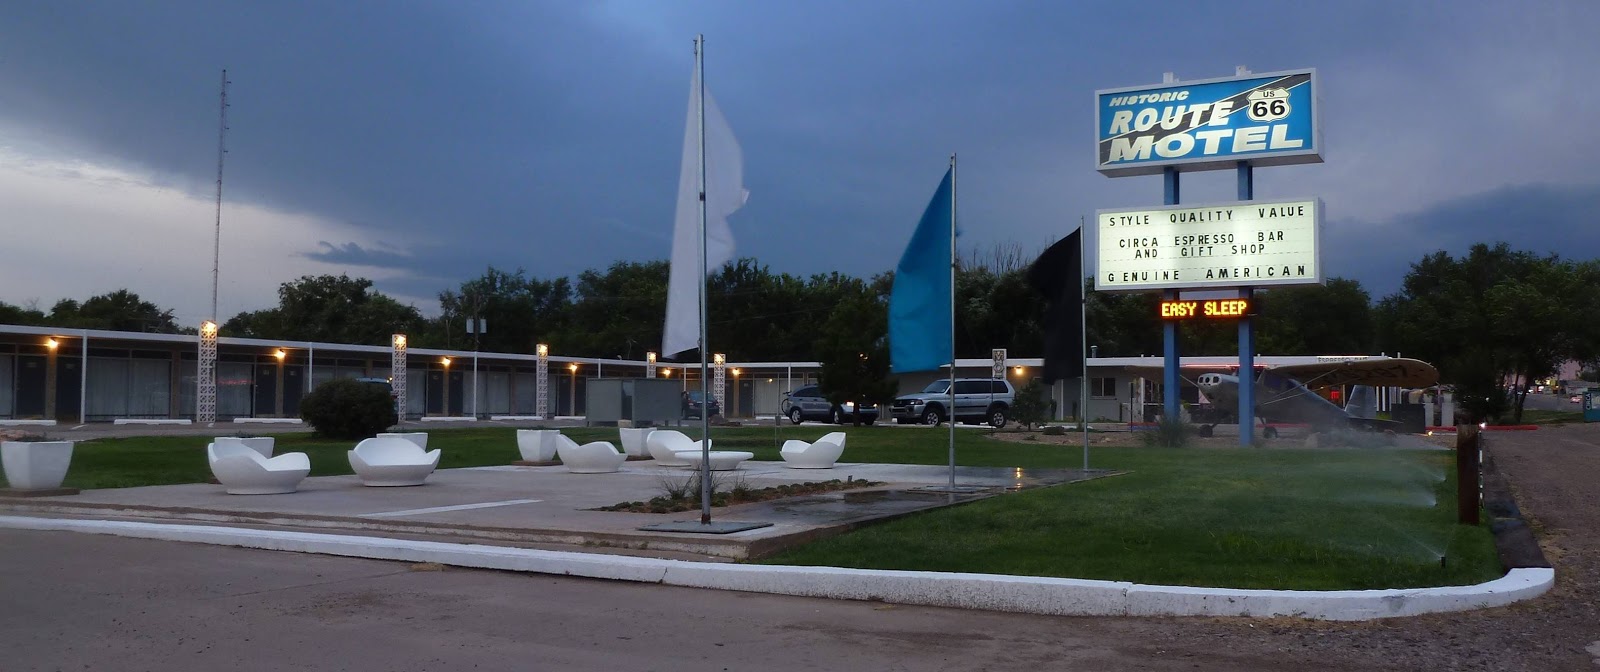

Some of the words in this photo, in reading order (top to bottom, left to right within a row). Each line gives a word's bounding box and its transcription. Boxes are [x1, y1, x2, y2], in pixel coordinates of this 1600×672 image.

[1109, 90, 1190, 107] HISTORIC
[1262, 90, 1275, 98] US
[1252, 99, 1286, 118] 66
[1109, 100, 1234, 135] ROUTE
[1108, 124, 1304, 162] MOTEL
[1109, 214, 1150, 227] STYLE
[1169, 210, 1233, 223] QUALITY
[1258, 205, 1304, 218] VALUE
[1119, 237, 1159, 248] CIRCA
[1174, 233, 1234, 246] ESPRESSO
[1258, 230, 1284, 242] BAR
[1134, 248, 1158, 259] AND
[1181, 246, 1214, 257] GIFT
[1231, 243, 1265, 255] SHOP
[1108, 270, 1180, 282] GENUINE
[1205, 265, 1306, 279] AMERICAN
[1161, 301, 1196, 317] EASY
[1204, 300, 1247, 316] SLEEP
